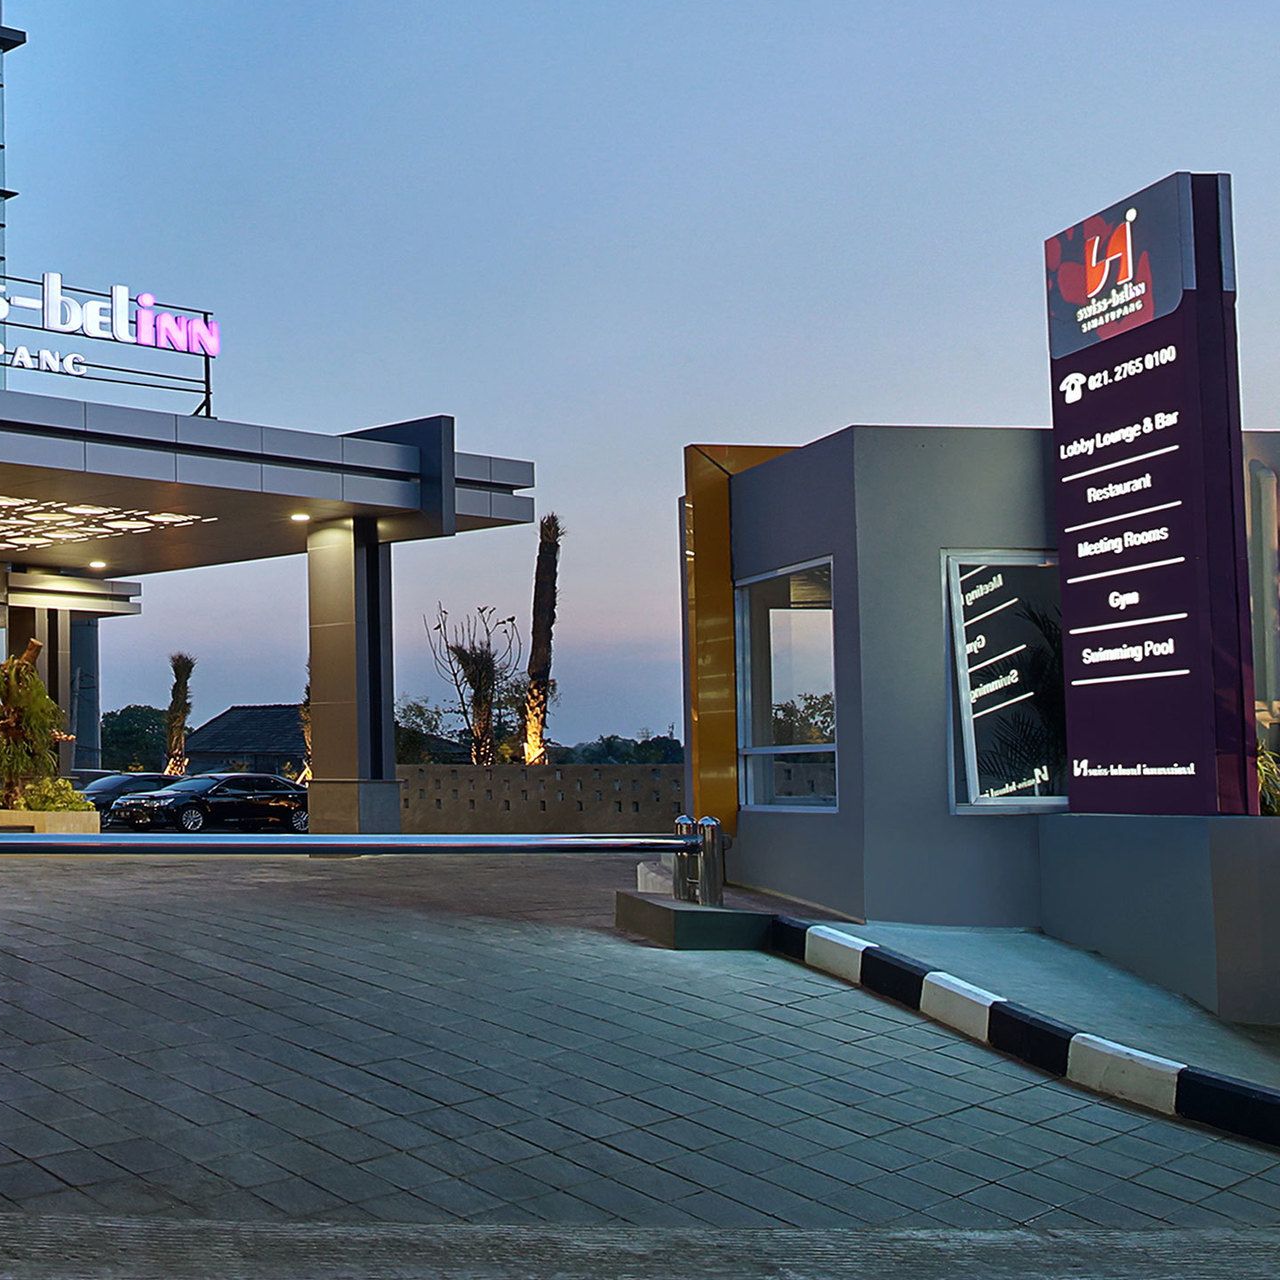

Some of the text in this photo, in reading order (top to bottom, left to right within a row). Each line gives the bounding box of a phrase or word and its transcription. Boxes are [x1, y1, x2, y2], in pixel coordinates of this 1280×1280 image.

[1081, 300, 1143, 333] SIMATUPANG
[1114, 357, 1143, 382] 2765
[1144, 345, 1176, 370] 0100
[1060, 411, 1179, 459] Lobby Lounge & Bar
[1086, 473, 1152, 503] Restaurant
[1077, 527, 1169, 558] Meeting Rooms
[1108, 591, 1140, 610] Gym
[1082, 638, 1175, 664] Swimming Pool
